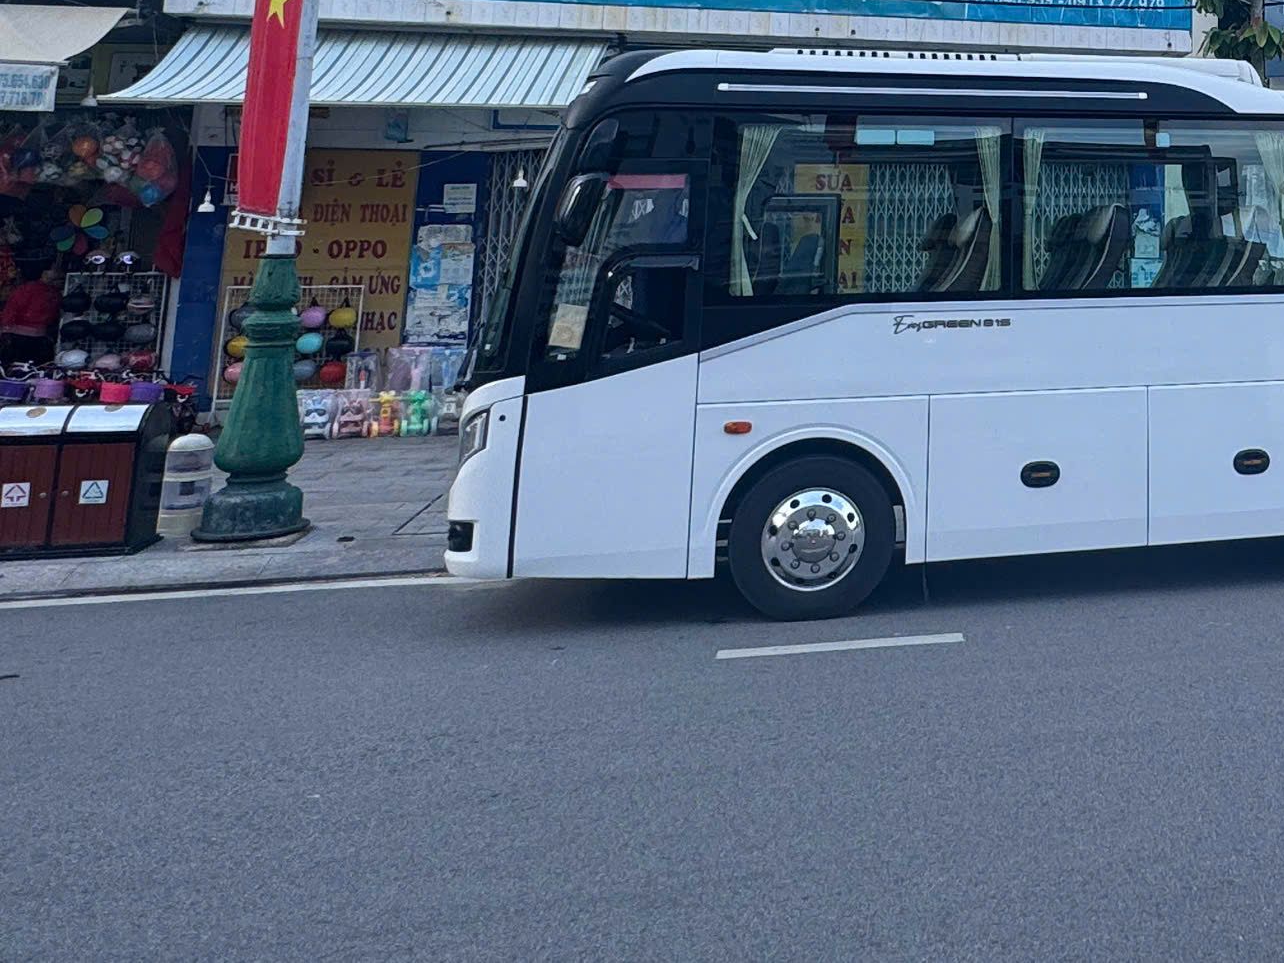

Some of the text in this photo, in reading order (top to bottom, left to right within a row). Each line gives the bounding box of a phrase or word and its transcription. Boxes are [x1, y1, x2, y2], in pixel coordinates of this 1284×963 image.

[312, 199, 351, 226] ĐIỆN
[360, 203, 408, 227] THOẠI
[327, 239, 388, 259] OPPO
